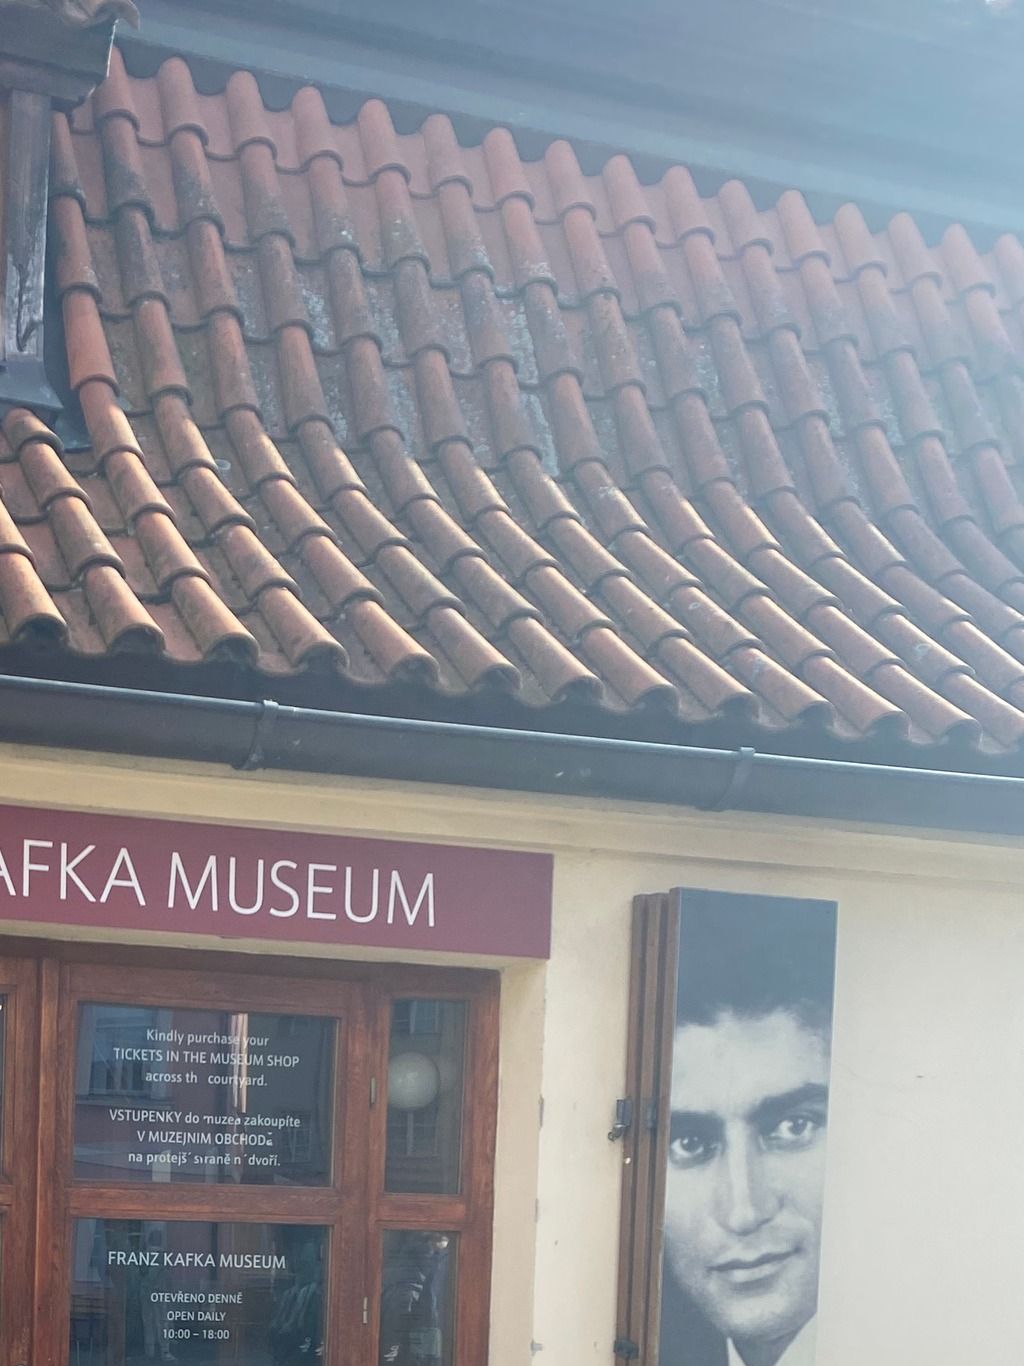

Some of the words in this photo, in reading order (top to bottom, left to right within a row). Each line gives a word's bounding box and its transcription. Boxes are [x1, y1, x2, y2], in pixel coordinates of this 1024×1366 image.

[166, 851, 437, 928] MUSEUM
[146, 1028, 184, 1044] Kindly
[187, 1031, 240, 1046] purchase
[242, 1036, 270, 1049] your
[112, 1047, 163, 1062] TICKETS
[166, 1050, 180, 1062] IN
[182, 1051, 207, 1064] THE
[210, 1052, 264, 1066] MUSEUM
[266, 1055, 300, 1067] SHOP
[145, 1072, 183, 1083] across
[207, 1073, 268, 1088] courtyard.
[109, 1108, 182, 1124] VSTUPENKY
[184, 1112, 200, 1124] do
[243, 1114, 301, 1129] zakoupíte
[136, 1130, 146, 1142] V
[148, 1130, 212, 1145] MUZEJNIM
[128, 1153, 143, 1163] na
[146, 1151, 191, 1166] protejš
[108, 1250, 159, 1266] FRANZ
[163, 1252, 216, 1267] KAFKA
[219, 1253, 286, 1269] MUSEUM
[150, 1290, 206, 1303] OTEVŘENO
[207, 1291, 243, 1304] DENNĚ
[166, 1310, 195, 1321] OPEN
[197, 1311, 226, 1322] DAILY
[162, 1328, 191, 1339] 10:00
[202, 1329, 230, 1340] 18:00
